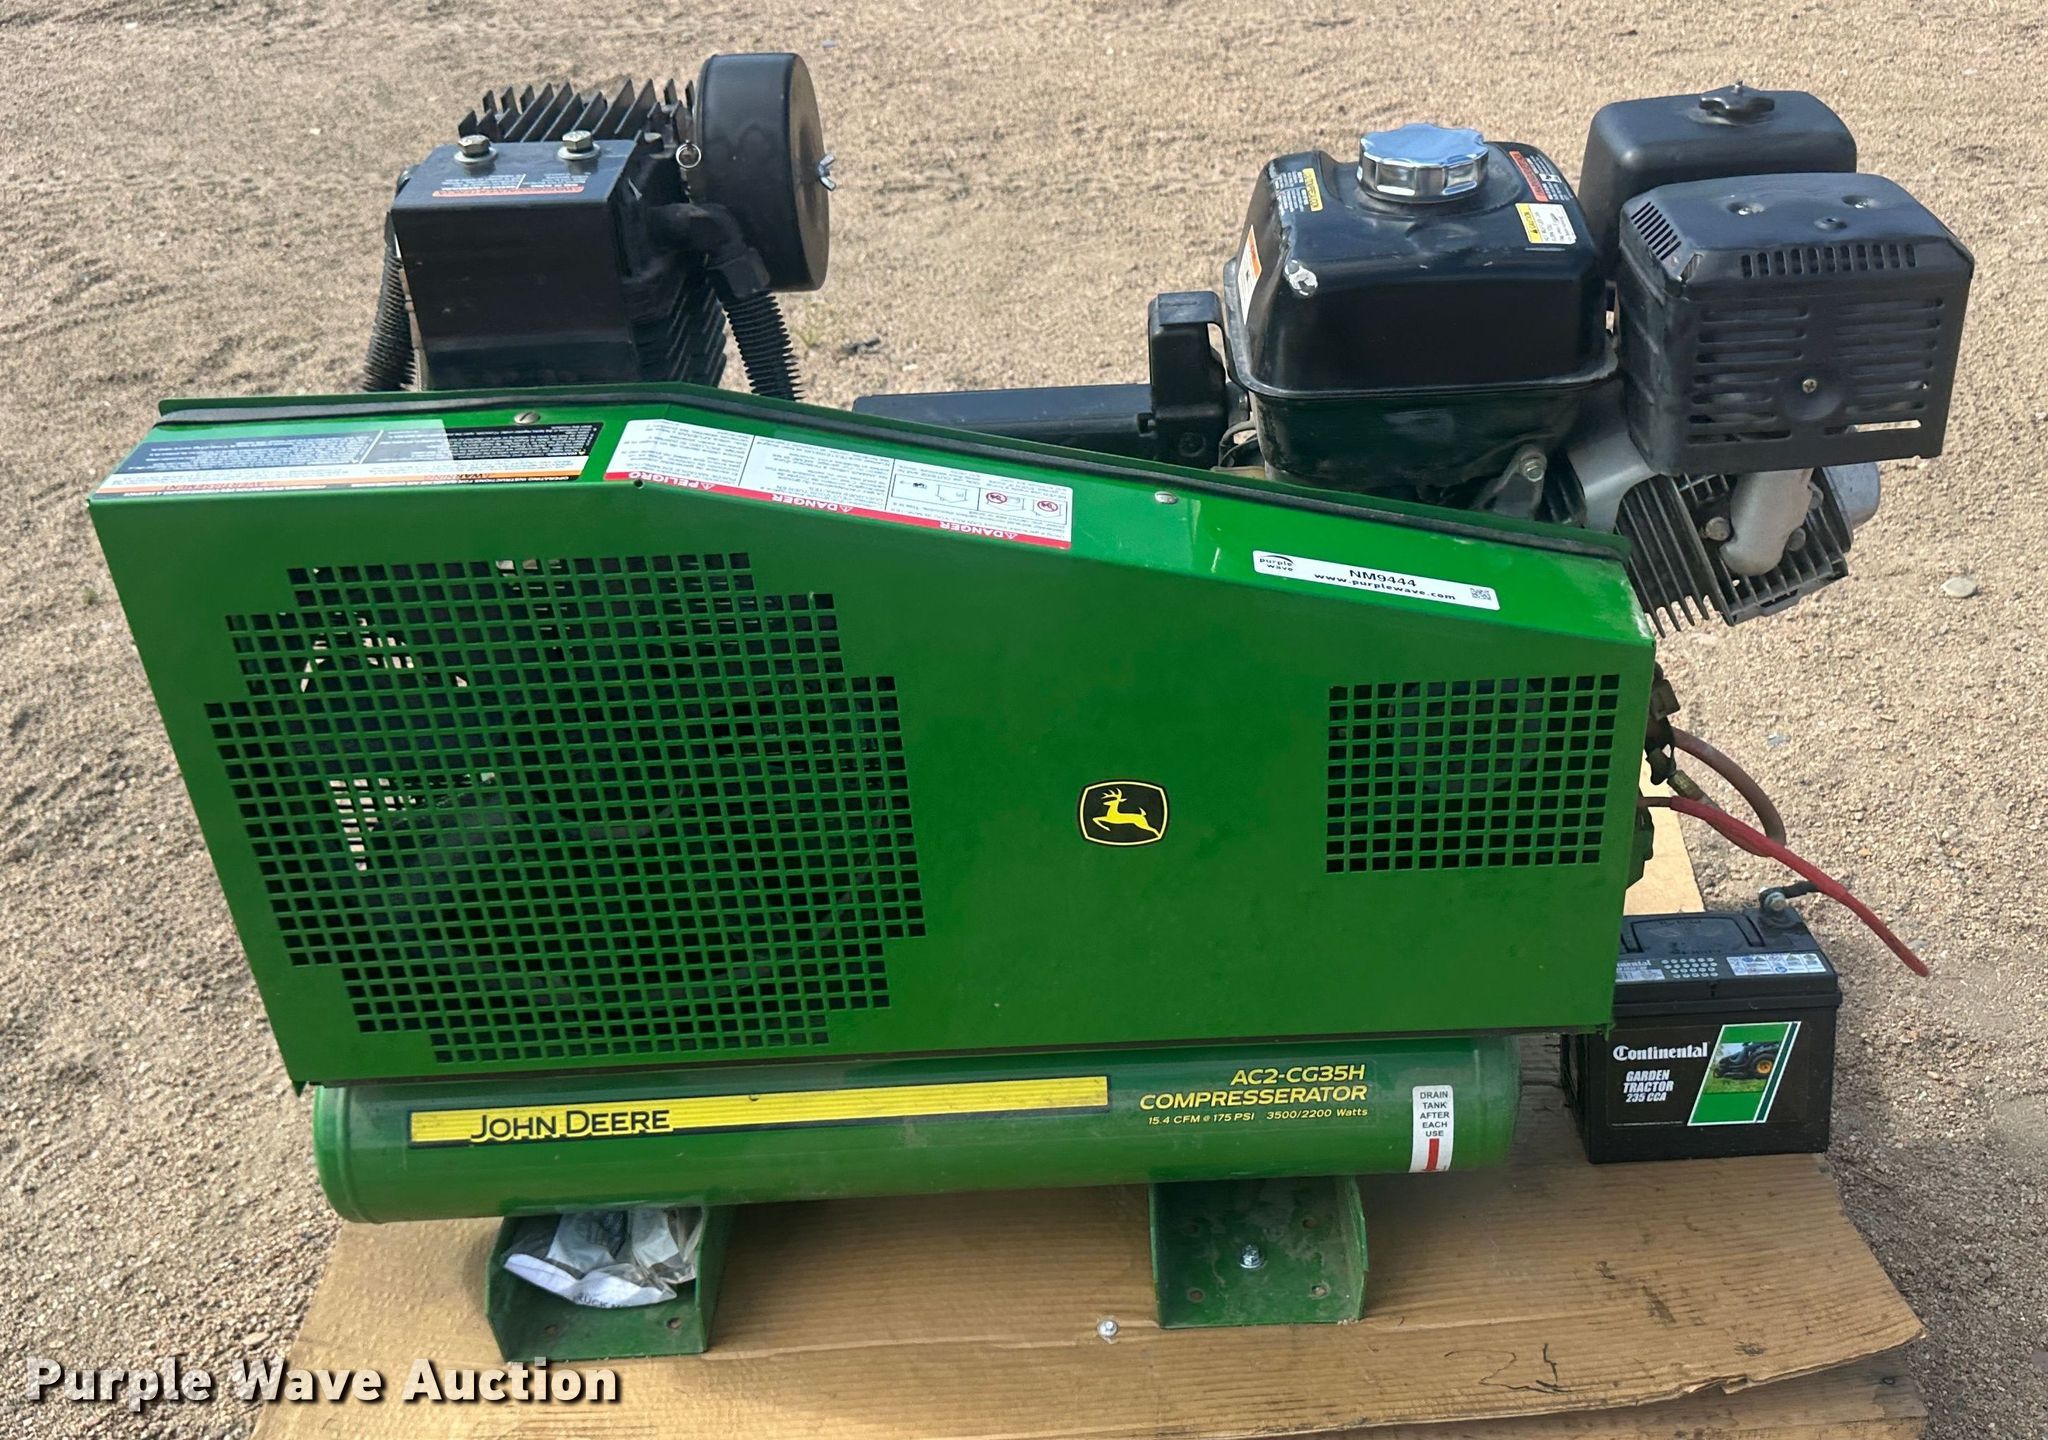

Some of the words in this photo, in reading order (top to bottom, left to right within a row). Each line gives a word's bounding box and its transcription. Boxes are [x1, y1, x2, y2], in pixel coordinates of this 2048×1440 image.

[627, 471, 702, 489] PELIGRO
[772, 493, 837, 513] DANGER
[939, 520, 1004, 539] DANGER
[1259, 557, 1293, 567] purple
[1266, 563, 1294, 572] wave
[1349, 569, 1417, 588] NM9444
[1314, 573, 1456, 601] www.purplewave.com
[1612, 1041, 1709, 1062] Continental
[1230, 1064, 1367, 1086] AC2-CG35H
[1626, 1069, 1671, 1082] GARDEN
[1623, 1081, 1674, 1093] TRACTOR
[1139, 1085, 1369, 1111] COMPRESSERATOR
[1419, 1091, 1449, 1100] DRAIN
[1625, 1092, 1646, 1103] 235
[1646, 1091, 1667, 1102] CCA
[1422, 1101, 1447, 1110] TANK
[1148, 1115, 1171, 1126] 15.4
[1173, 1114, 1200, 1125] CFM
[1213, 1112, 1233, 1123] 175
[1233, 1112, 1256, 1122] PSI
[1266, 1109, 1332, 1120] 3500/2200
[1336, 1107, 1369, 1118] Watts
[1419, 1111, 1450, 1120] AFTER
[470, 1114, 557, 1141] JOHN
[566, 1108, 671, 1134] DEERE
[1422, 1121, 1448, 1130] EACH
[1425, 1130, 1445, 1138] USE
